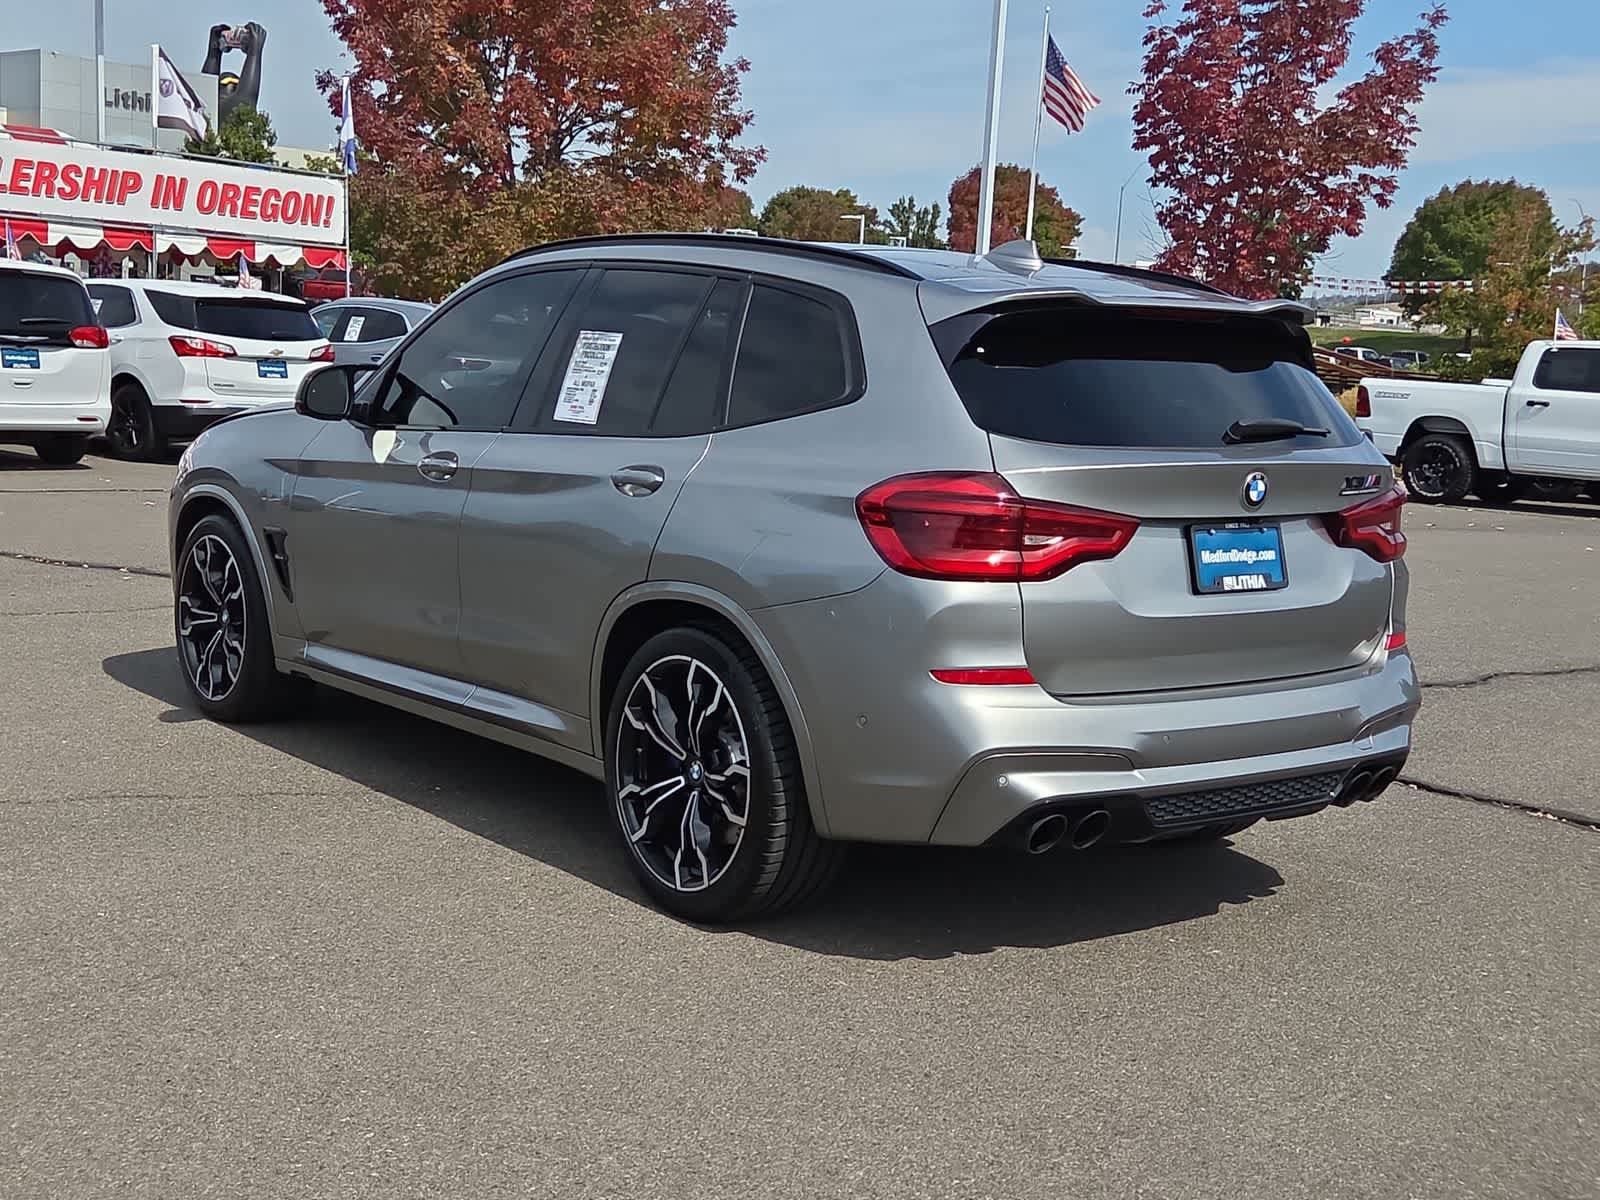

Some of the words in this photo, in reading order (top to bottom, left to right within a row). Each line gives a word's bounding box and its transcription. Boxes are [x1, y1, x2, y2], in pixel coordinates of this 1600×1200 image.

[104, 87, 153, 112] Lithi
[150, 174, 189, 211] IN
[196, 180, 336, 228] OREGON!
[1233, 574, 1267, 590] LITHIA
